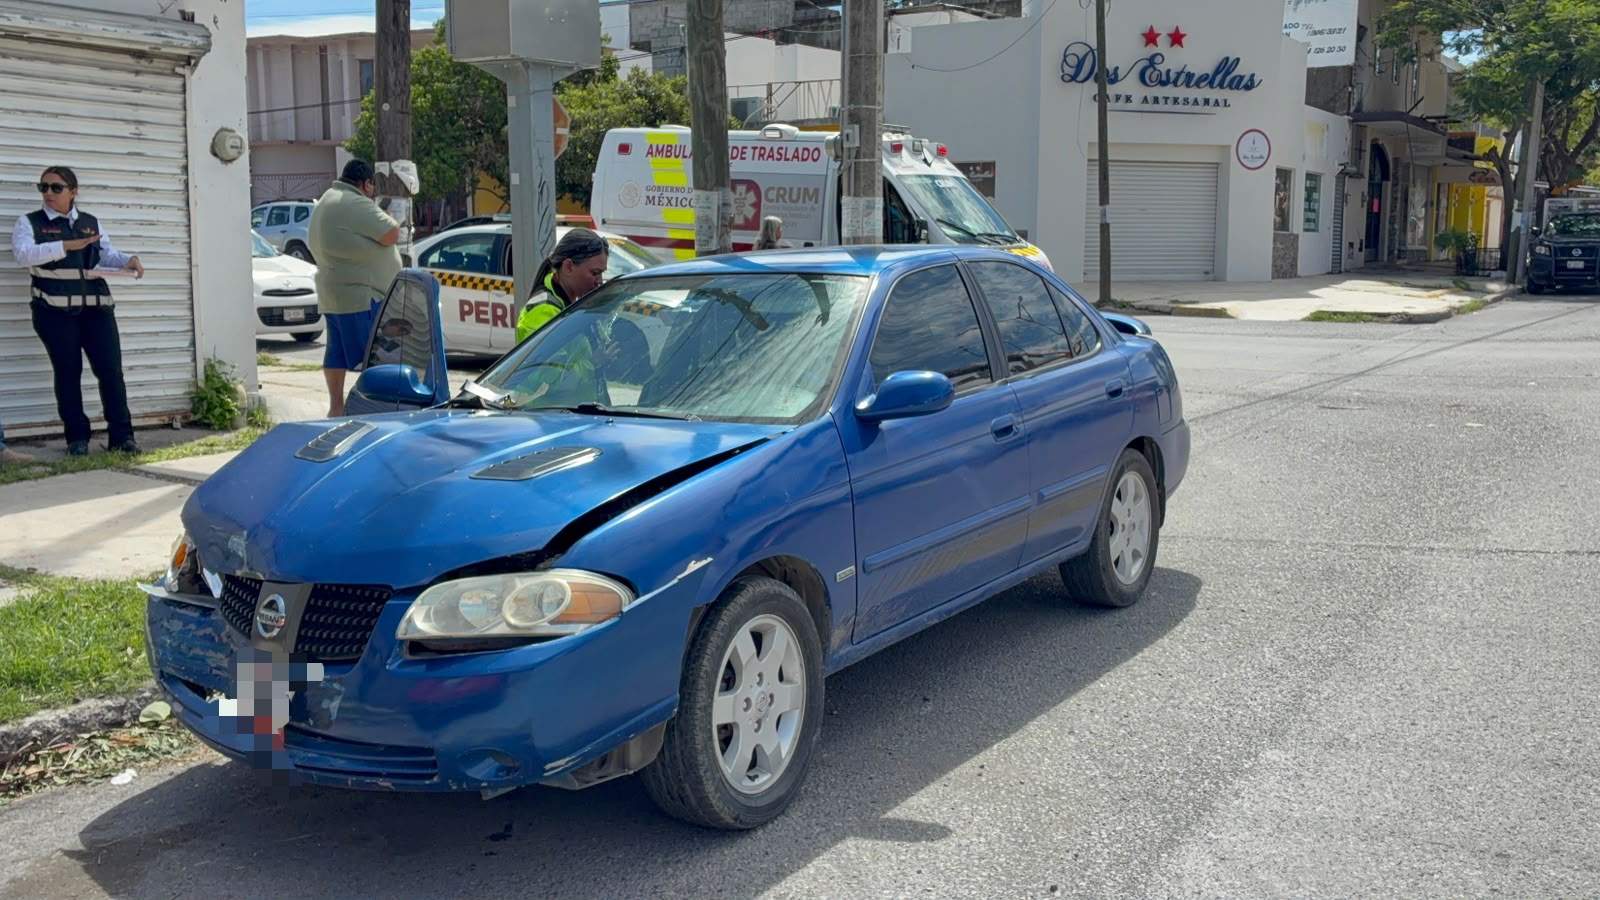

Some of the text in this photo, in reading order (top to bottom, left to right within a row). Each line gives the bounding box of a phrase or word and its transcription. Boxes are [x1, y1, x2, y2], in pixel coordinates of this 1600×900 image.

[1138, 52, 1263, 91] Estrellas
[1141, 95, 1231, 108] ARTESANAL
[730, 146, 748, 160] DE
[751, 146, 821, 162] TRASLADO
[646, 185, 686, 194] GOBIERNO
[764, 186, 820, 204] CRUM
